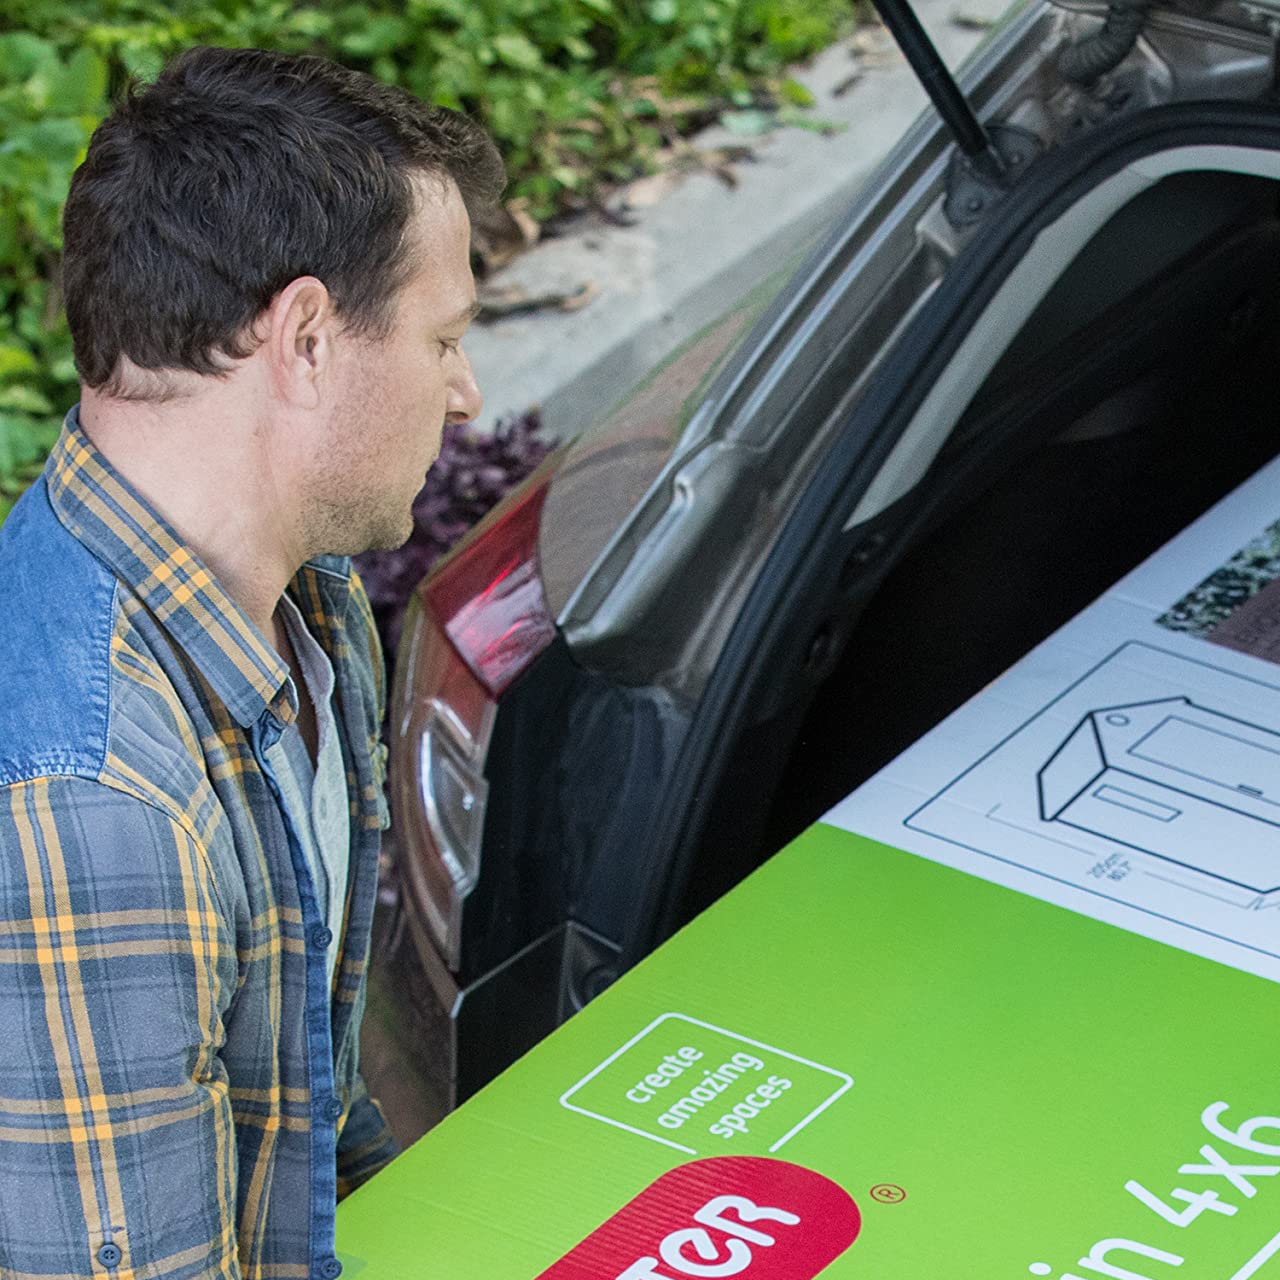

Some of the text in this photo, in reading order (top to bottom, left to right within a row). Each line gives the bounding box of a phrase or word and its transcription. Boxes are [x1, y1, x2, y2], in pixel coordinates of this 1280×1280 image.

[625, 1046, 704, 1103] create
[657, 1052, 765, 1129] amazing
[709, 1075, 792, 1139] spaces
